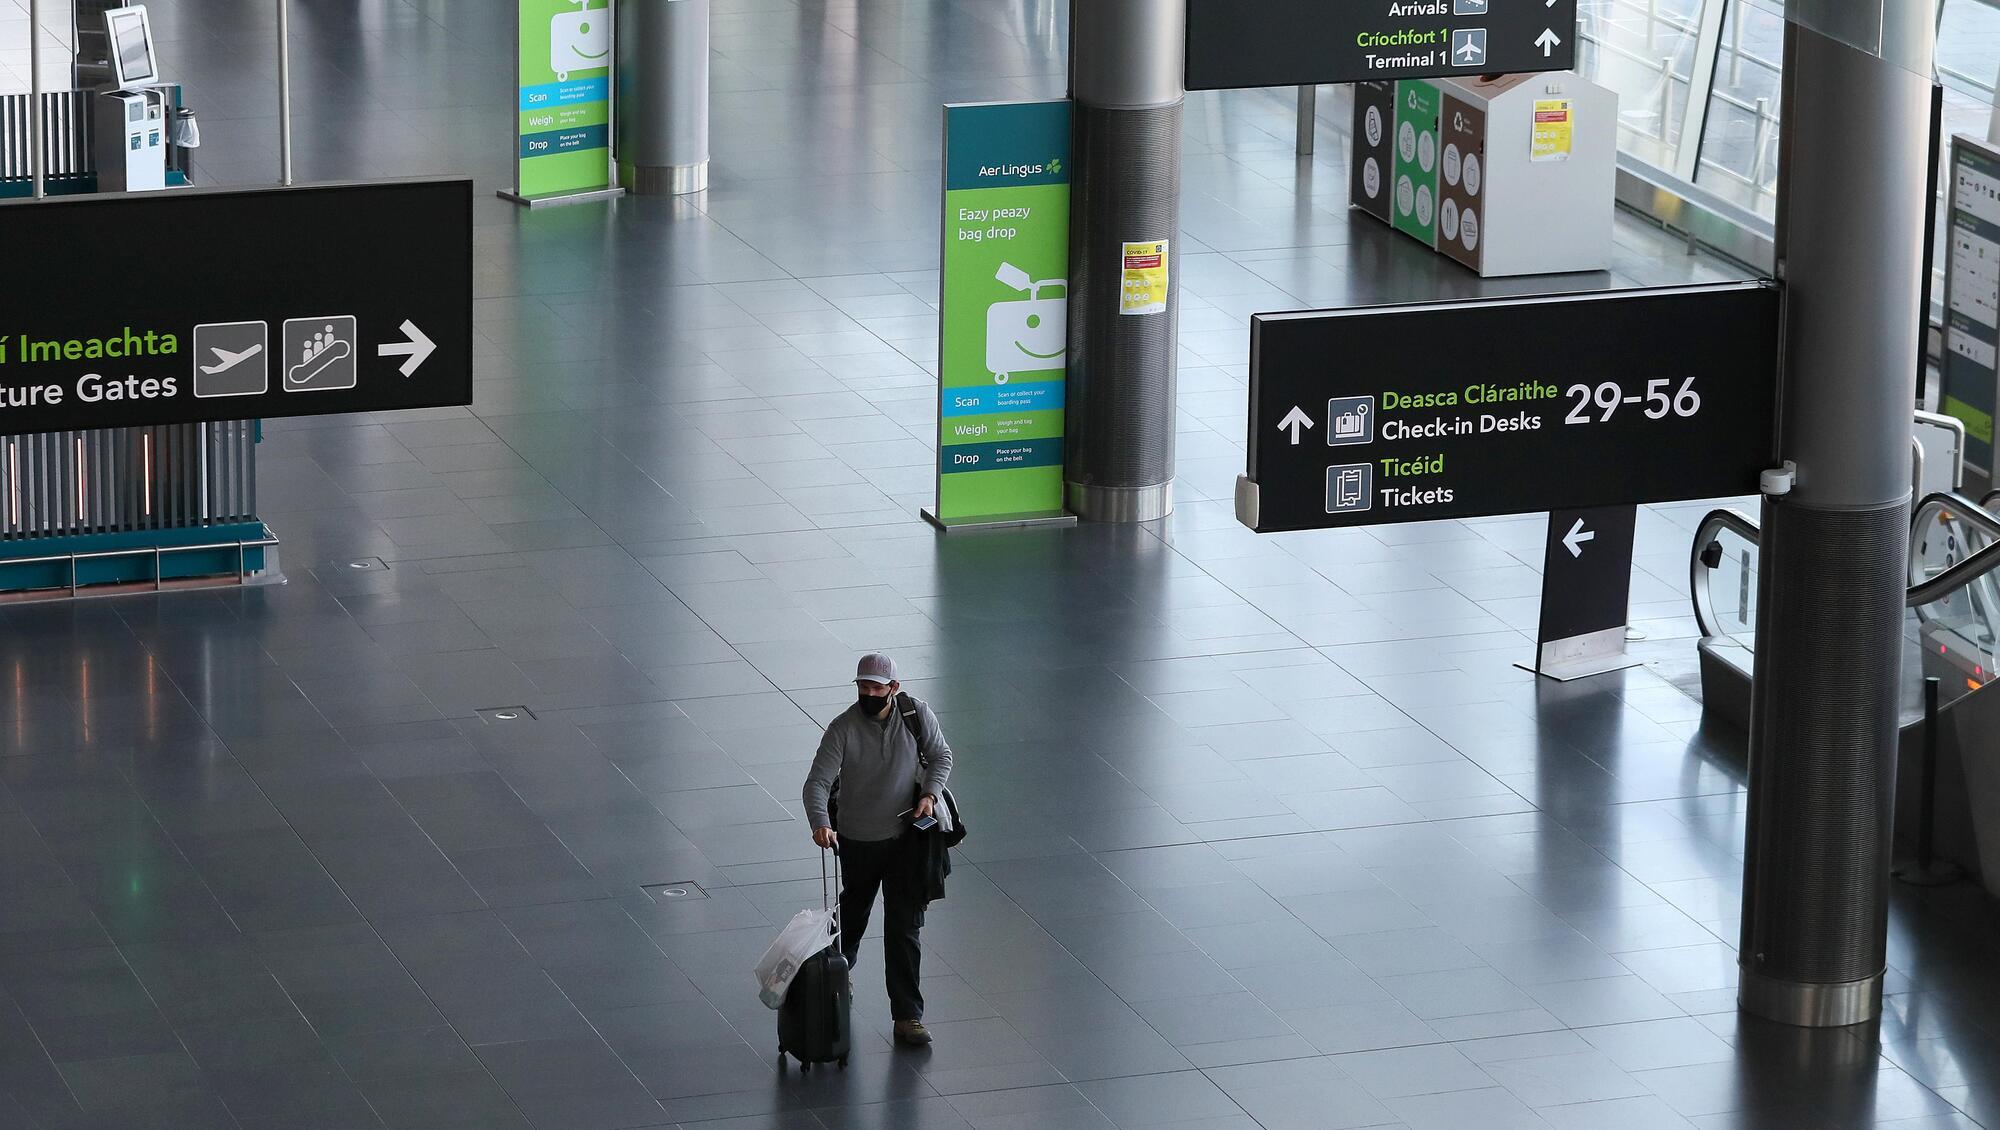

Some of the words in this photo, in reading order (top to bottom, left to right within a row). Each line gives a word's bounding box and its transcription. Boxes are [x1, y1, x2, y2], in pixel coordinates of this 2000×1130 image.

[1388, 0, 1448, 17] Arrivals
[1356, 29, 1436, 47] Críochfort
[1440, 28, 1448, 43] 1
[1365, 51, 1434, 69] Terminal
[1440, 51, 1447, 65] 1
[528, 93, 548, 103] Scan
[528, 115, 554, 126] Weigh
[529, 141, 548, 151] Drop
[978, 165, 1000, 177] Aer
[1002, 163, 1042, 178] Lingus
[959, 208, 989, 222] Eazy
[992, 207, 1031, 222] peazy
[958, 227, 982, 242] bag
[986, 226, 1016, 240] drop
[20, 326, 178, 363] Imeachta
[76, 373, 178, 403] Gates
[1381, 389, 1458, 411] Deasca
[1464, 380, 1558, 404] Cláraithe
[955, 397, 980, 408] Scan
[954, 423, 988, 437] Weigh
[1381, 418, 1473, 441] Check-in
[1479, 411, 1541, 434] Desks
[954, 454, 980, 466] Drop
[1380, 454, 1444, 477] Ticéid
[1380, 486, 1454, 507] Tickets
